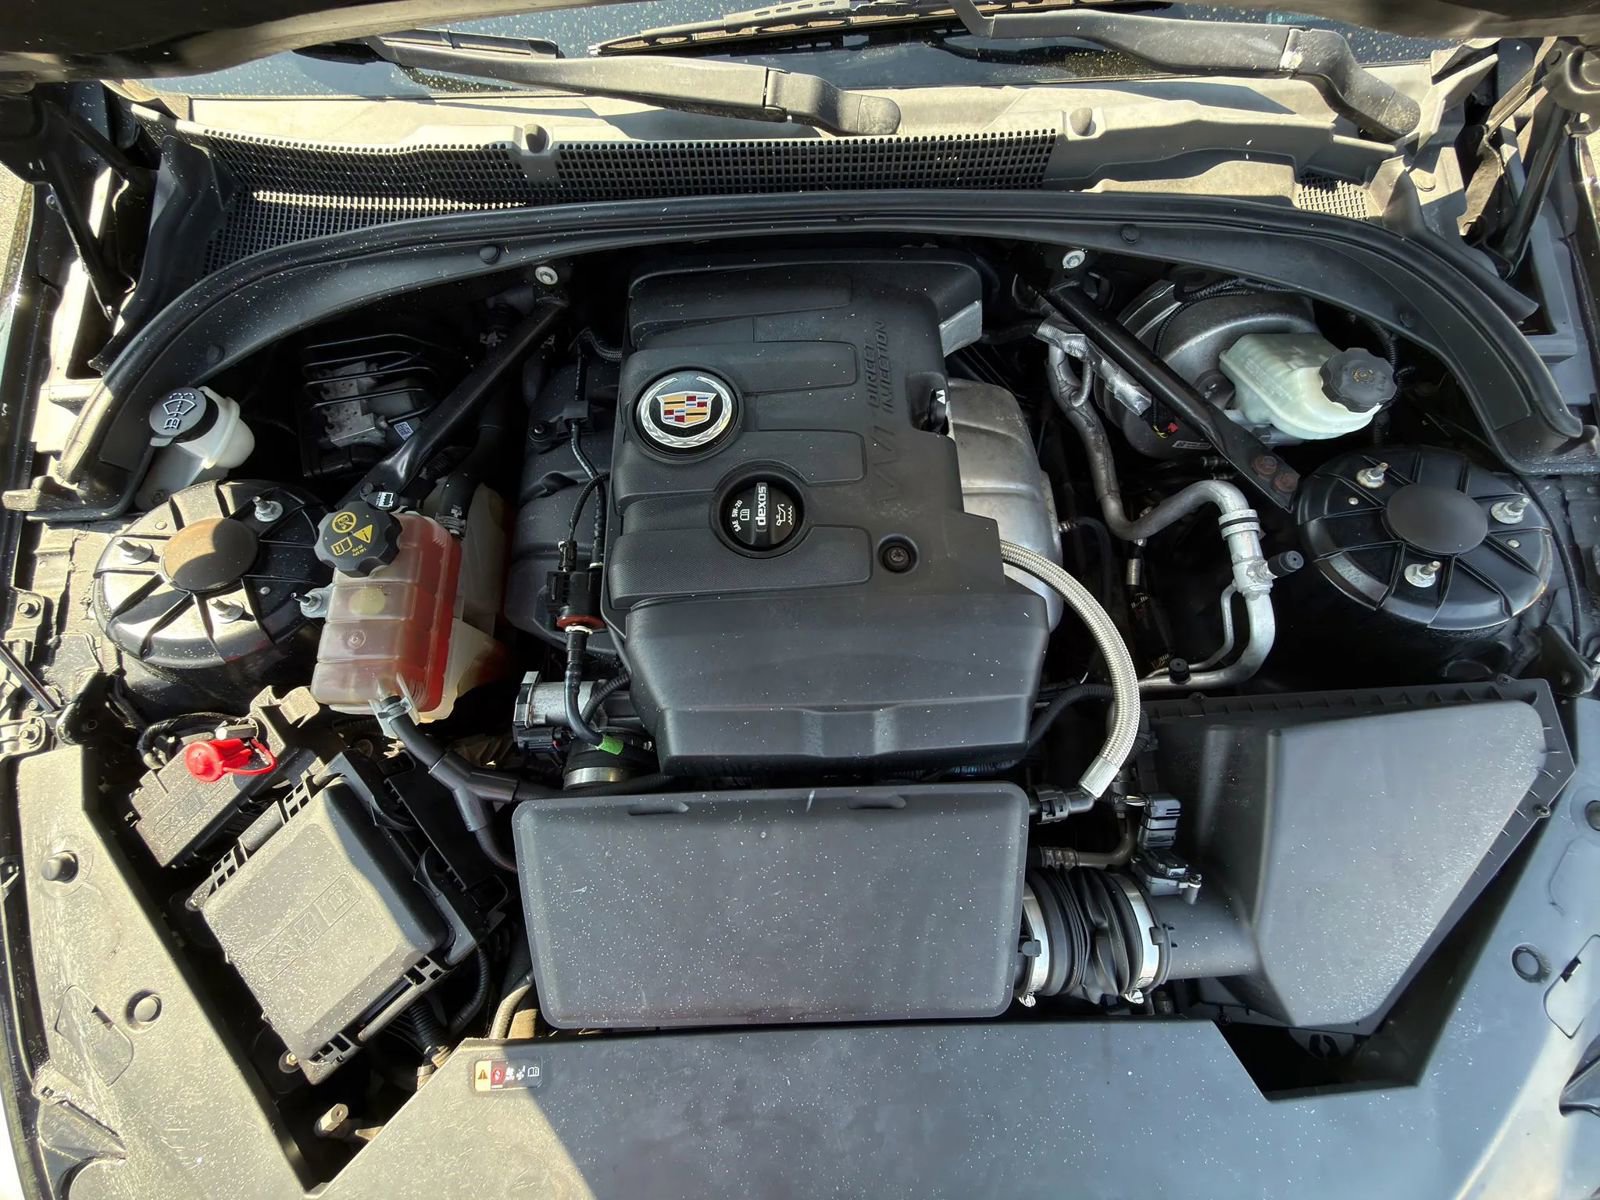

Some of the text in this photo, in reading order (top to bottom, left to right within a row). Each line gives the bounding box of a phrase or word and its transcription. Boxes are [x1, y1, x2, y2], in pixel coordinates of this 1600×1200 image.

[863, 341, 881, 409] DIRECT
[731, 519, 742, 532] SAE
[755, 485, 767, 526] dexos
